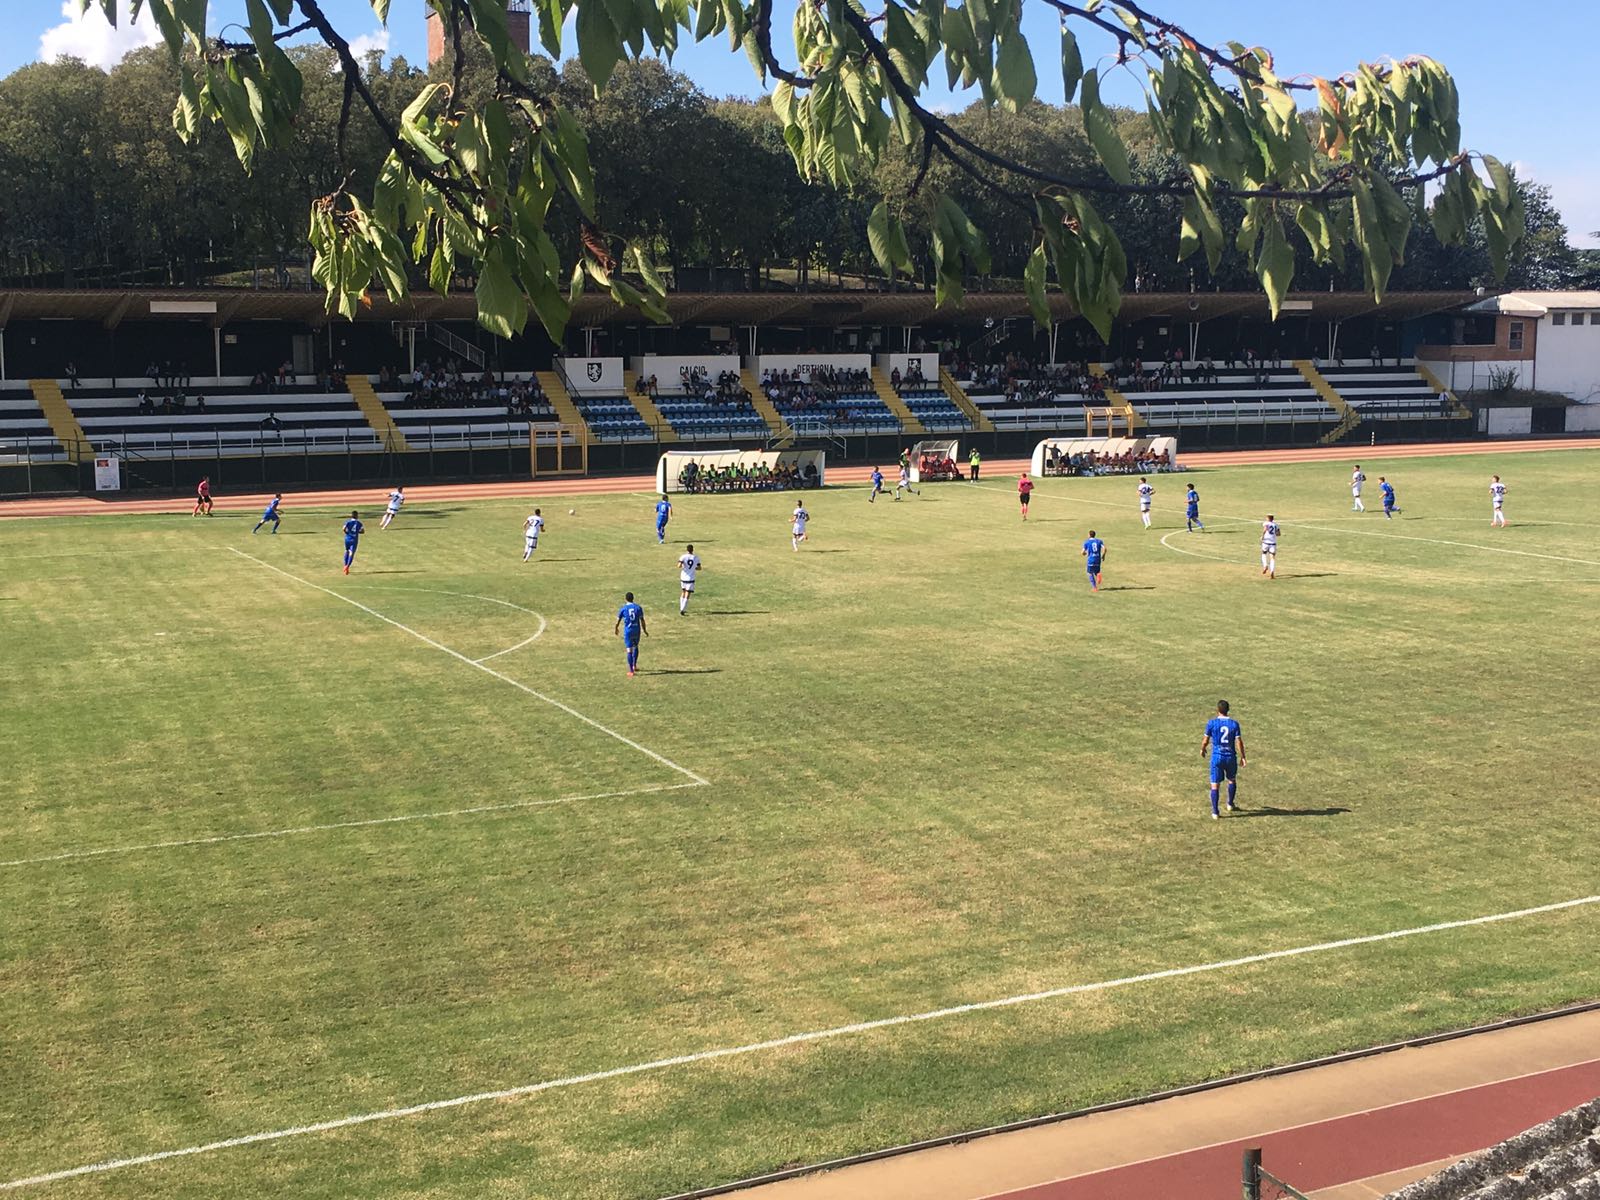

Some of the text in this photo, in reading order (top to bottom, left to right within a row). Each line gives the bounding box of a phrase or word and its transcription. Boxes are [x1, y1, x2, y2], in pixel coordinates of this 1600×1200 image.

[679, 365, 706, 376] CALCIO
[393, 495, 400, 503] 7
[351, 523, 357, 532] 4
[1092, 542, 1098, 553] 8
[687, 560, 693, 570] 9
[628, 608, 635, 621] 5
[1220, 726, 1230, 744] 2
